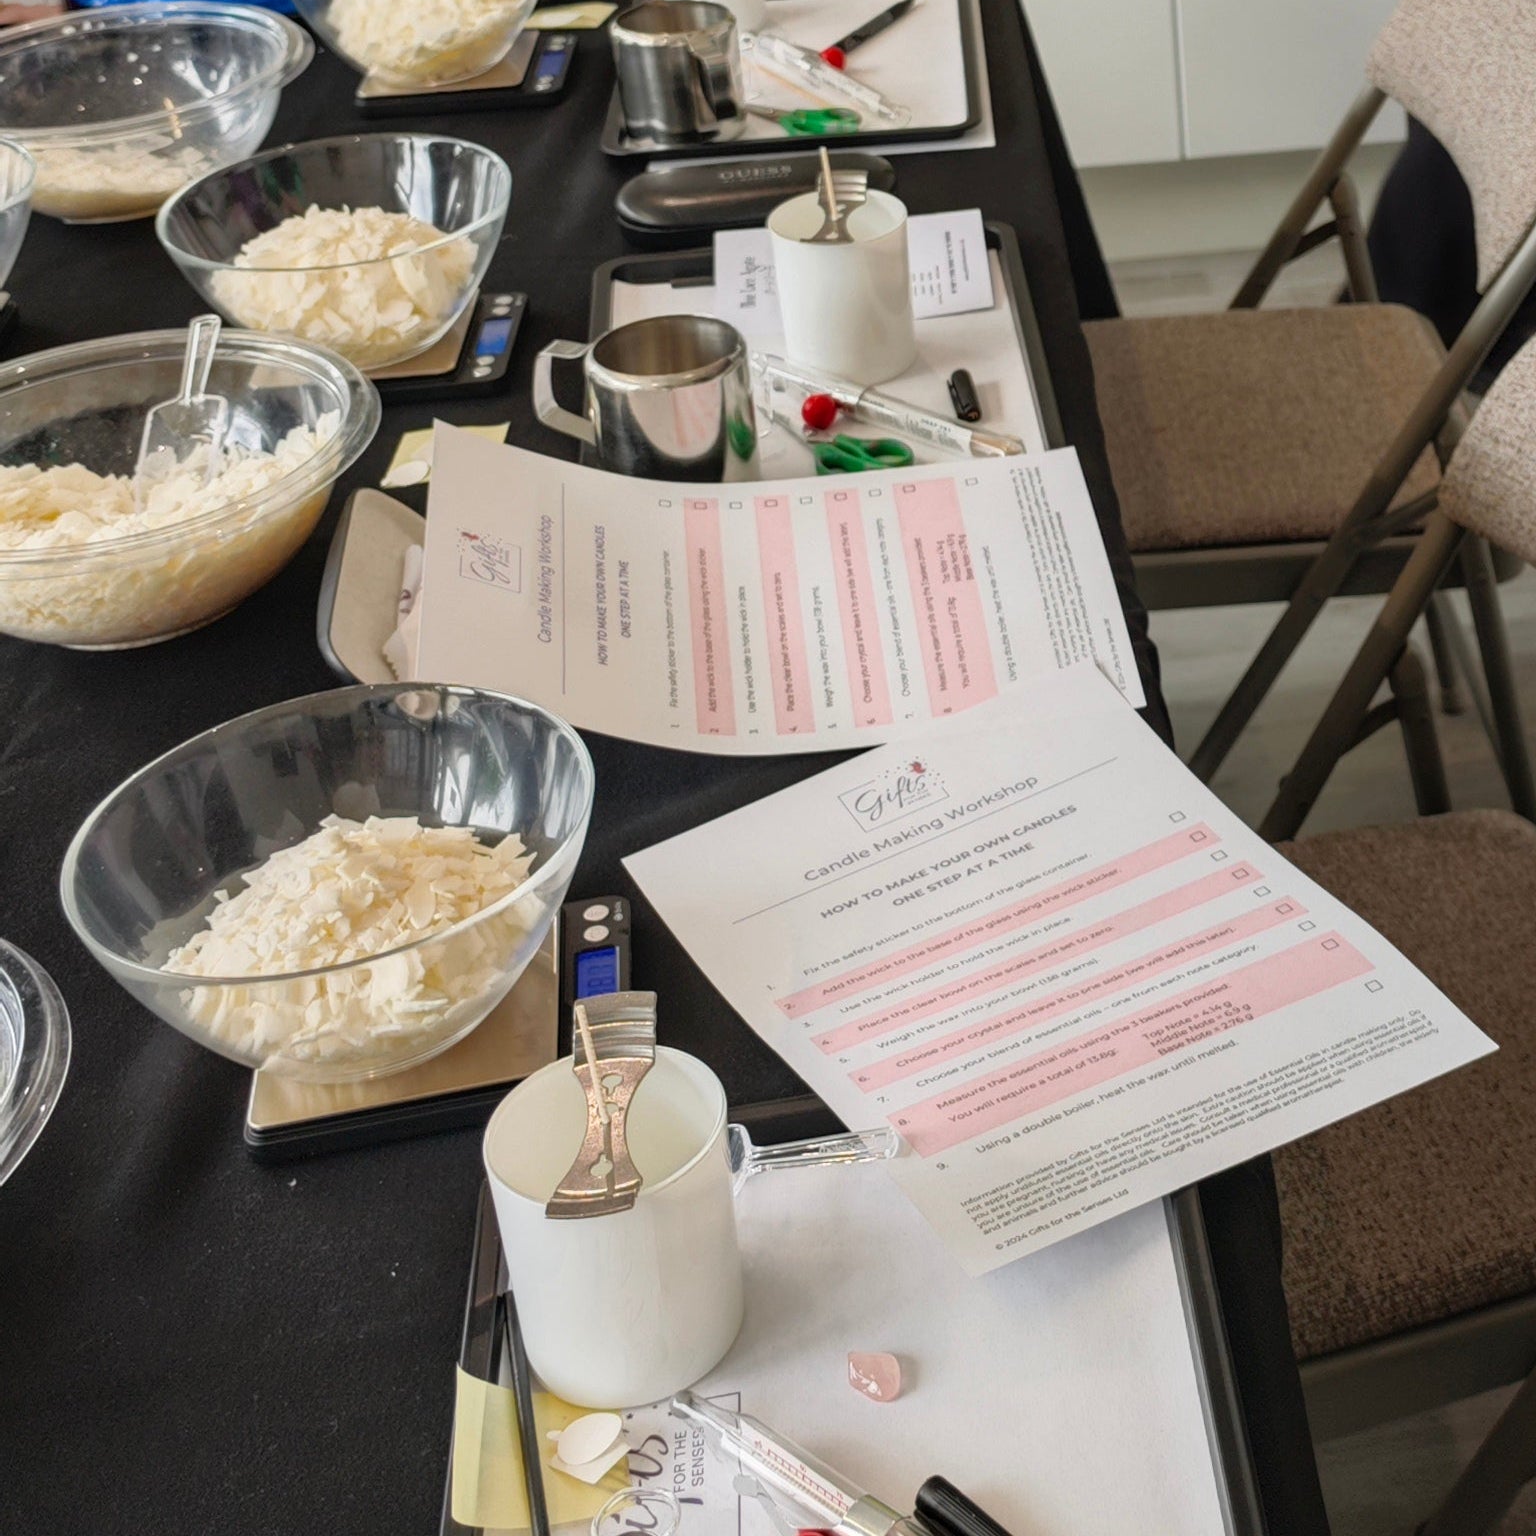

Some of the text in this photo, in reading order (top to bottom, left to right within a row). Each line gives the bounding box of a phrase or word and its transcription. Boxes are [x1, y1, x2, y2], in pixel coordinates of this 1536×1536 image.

[718, 165, 792, 180] GUESS
[469, 539, 511, 584] Gifts
[595, 524, 605, 560] CANDLES
[537, 514, 555, 643] Candle Making Workshop
[596, 559, 606, 581] OWN
[619, 559, 629, 578] TIME
[596, 581, 607, 603] YOUR
[620, 598, 631, 619] STEP
[597, 604, 607, 630] MAKE
[621, 619, 631, 638] ONE
[598, 642, 608, 665] HOW
[855, 775, 926, 822] Gifts
[803, 849, 870, 880] Candle
[872, 818, 944, 851] Making
[943, 776, 1037, 819] Workshop
[820, 804, 1076, 918] HOW TO MAKE YOUR OWN CANDLES
[892, 842, 1034, 906] ONE STEP AT A TIME
[822, 982, 845, 995] Add
[845, 974, 865, 985] the
[866, 964, 892, 976] wick
[906, 950, 925, 960] the
[925, 939, 952, 952] base
[953, 932, 964, 941] of
[964, 926, 984, 936] the
[984, 914, 1012, 929] glass
[1012, 901, 1042, 916] using
[1041, 893, 1060, 904] the
[1061, 883, 1084, 896] wick
[1085, 868, 1121, 885] sticker.
[895, 1048, 938, 1067] Choose
[939, 1037, 964, 1051] your
[967, 1021, 1003, 1039] crystal
[1004, 1012, 1026, 1025] and
[1026, 1000, 1056, 1015] leave
[1066, 991, 1079, 999] to
[1079, 982, 1101, 994] one
[1102, 973, 1124, 985] side
[1145, 955, 1164, 966] will
[1164, 946, 1185, 958] add
[1185, 939, 1206, 949] this
[1141, 1028, 1164, 1039] Top
[1164, 1017, 1192, 1031] Note
[1201, 1004, 1222, 1015] 4.14
[1222, 1000, 1232, 1008] g
[1149, 1029, 1188, 1047] Middle
[1187, 1017, 1215, 1032] Note
[1241, 1003, 1251, 1011] g
[935, 1085, 985, 1109] Measure
[986, 1076, 1007, 1087] the
[1008, 1054, 1058, 1078] essential
[1058, 1047, 1078, 1057] oils
[1079, 1033, 1111, 1049] using
[1110, 1025, 1130, 1036] the
[1138, 1003, 1182, 1024] beakers
[1157, 1041, 1185, 1056] Base
[1184, 1029, 1212, 1044] Note
[1220, 1015, 1244, 1029] 2.76
[947, 1109, 972, 1122] You
[973, 1099, 995, 1112] will
[995, 1082, 1036, 1103] require
[1046, 1065, 1074, 1081] total
[1074, 1060, 1086, 1069] of
[975, 1135, 1011, 1153] Using
[1021, 1113, 1062, 1134] double
[1062, 1098, 1099, 1116] boiler,
[1098, 1086, 1125, 1101] heat
[1125, 1078, 1146, 1089] the
[1146, 1068, 1170, 1080] wax
[1170, 1055, 1196, 1071] until
[1197, 1039, 1239, 1060] melted.
[1003, 1232, 1028, 1246] 2024
[1027, 1223, 1050, 1235] Gifts
[1049, 1217, 1063, 1226] for
[1064, 1210, 1081, 1220] the
[1080, 1196, 1113, 1213] Senses
[1112, 1188, 1129, 1199] Ltd
[673, 1425, 705, 1494] FOR THE SENSES
